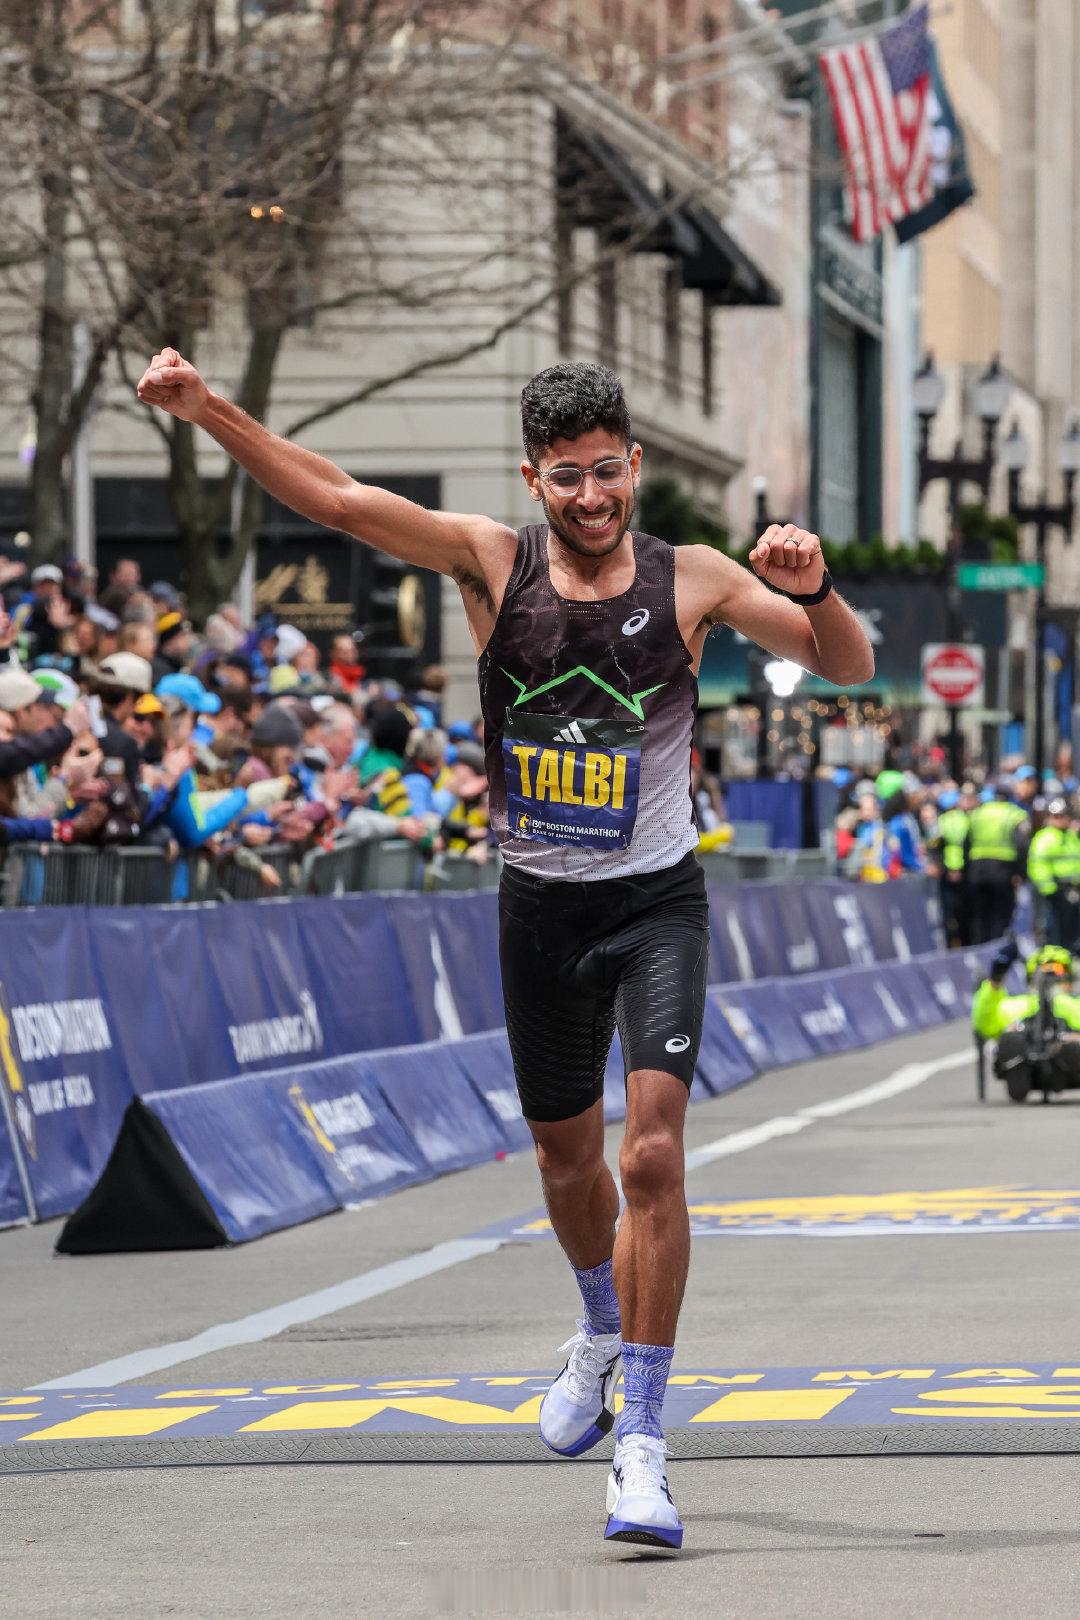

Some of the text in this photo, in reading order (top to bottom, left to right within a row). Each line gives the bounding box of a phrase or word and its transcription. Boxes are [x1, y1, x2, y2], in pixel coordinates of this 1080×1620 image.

[512, 746, 627, 810] TALBI
[546, 823, 576, 834] BOSTON
[576, 826, 621, 838] MARATHON
[154, 1374, 766, 1399] BOSTN
